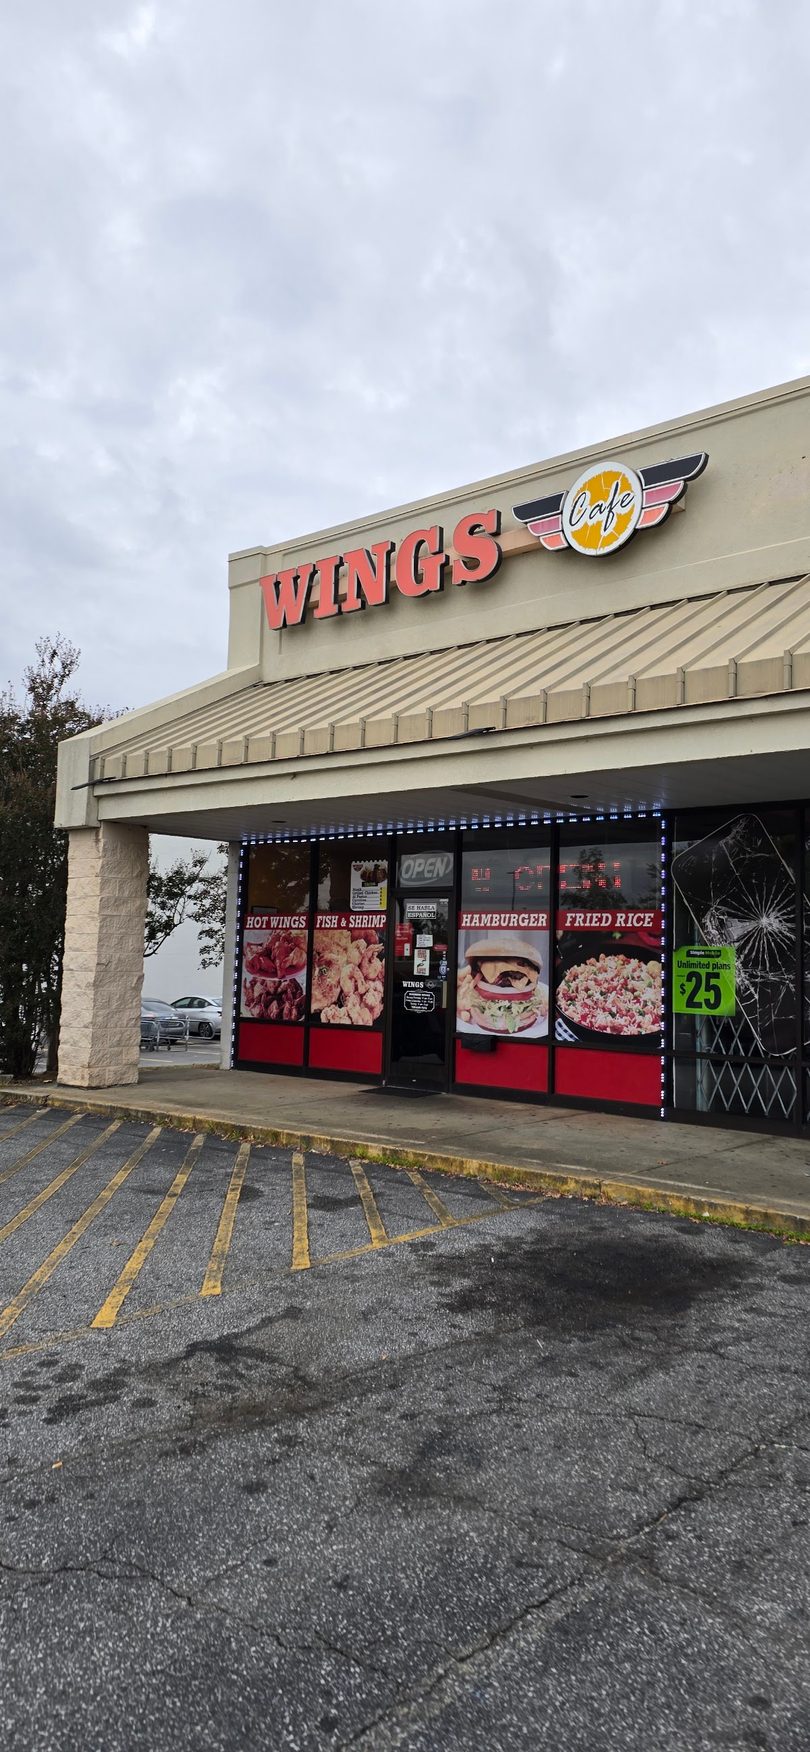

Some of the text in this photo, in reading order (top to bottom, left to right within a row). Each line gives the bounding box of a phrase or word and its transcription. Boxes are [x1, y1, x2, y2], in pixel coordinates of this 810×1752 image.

[568, 480, 636, 533] Cafe
[260, 509, 502, 630] WINGS
[401, 856, 448, 879] OPEN
[246, 915, 307, 929] HOT WINGS
[316, 916, 387, 929] FISH & SHRIMP
[462, 913, 548, 927] HAMBURGER
[564, 912, 655, 927] FRIED RICE
[677, 960, 731, 971] Unlimited plans
[402, 980, 424, 988] WINGS
